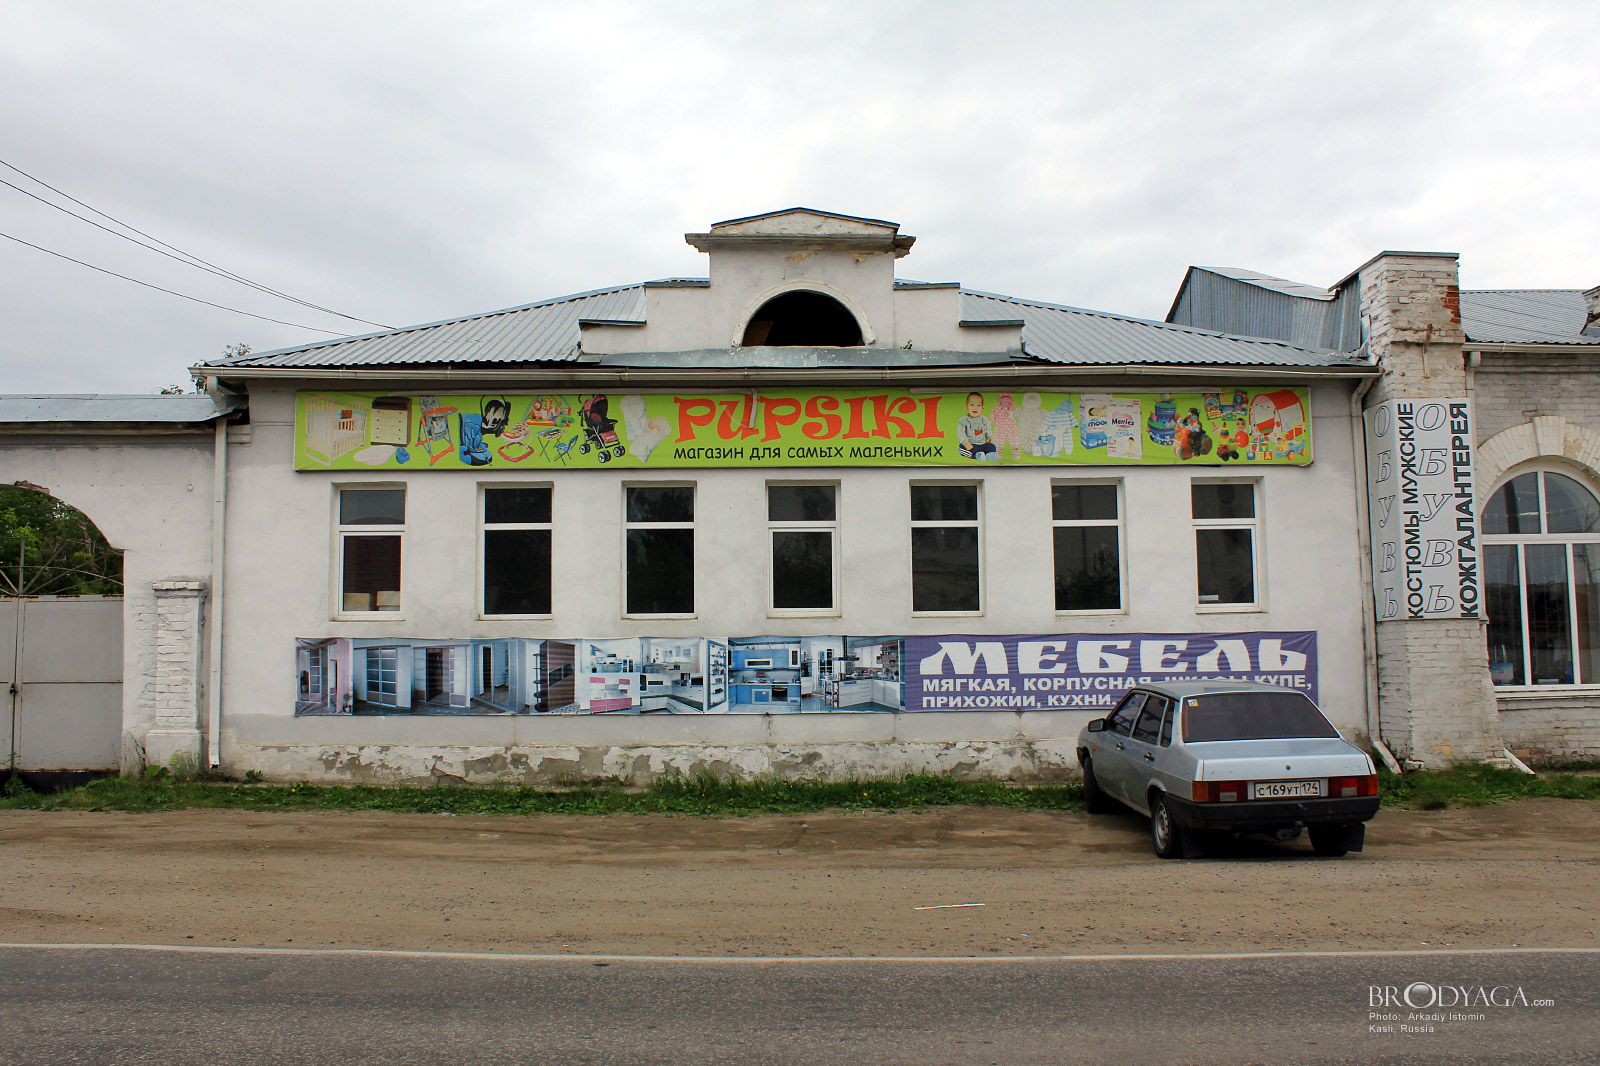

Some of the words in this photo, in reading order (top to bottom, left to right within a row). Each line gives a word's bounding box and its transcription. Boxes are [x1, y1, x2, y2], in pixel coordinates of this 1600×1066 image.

[674, 446, 744, 459] магазин
[749, 446, 781, 460] для
[787, 446, 844, 458] самых
[849, 445, 943, 458] маленьких
[1398, 403, 1418, 504] МУЖСКИЕ
[1374, 405, 1398, 618] ОБУВЬ
[1415, 403, 1454, 613] ОБУВЬ
[1449, 403, 1479, 617] КОЖГАЛАНТЕРЕЯ
[1403, 511, 1424, 619] КОСТЮМЫ
[919, 639, 1308, 675] МЕБЕЛЬ
[922, 678, 1016, 694] МЯГКАЯ,
[1047, 694, 1117, 706] КУХНИ.
[1301, 782, 1319, 792] 174
